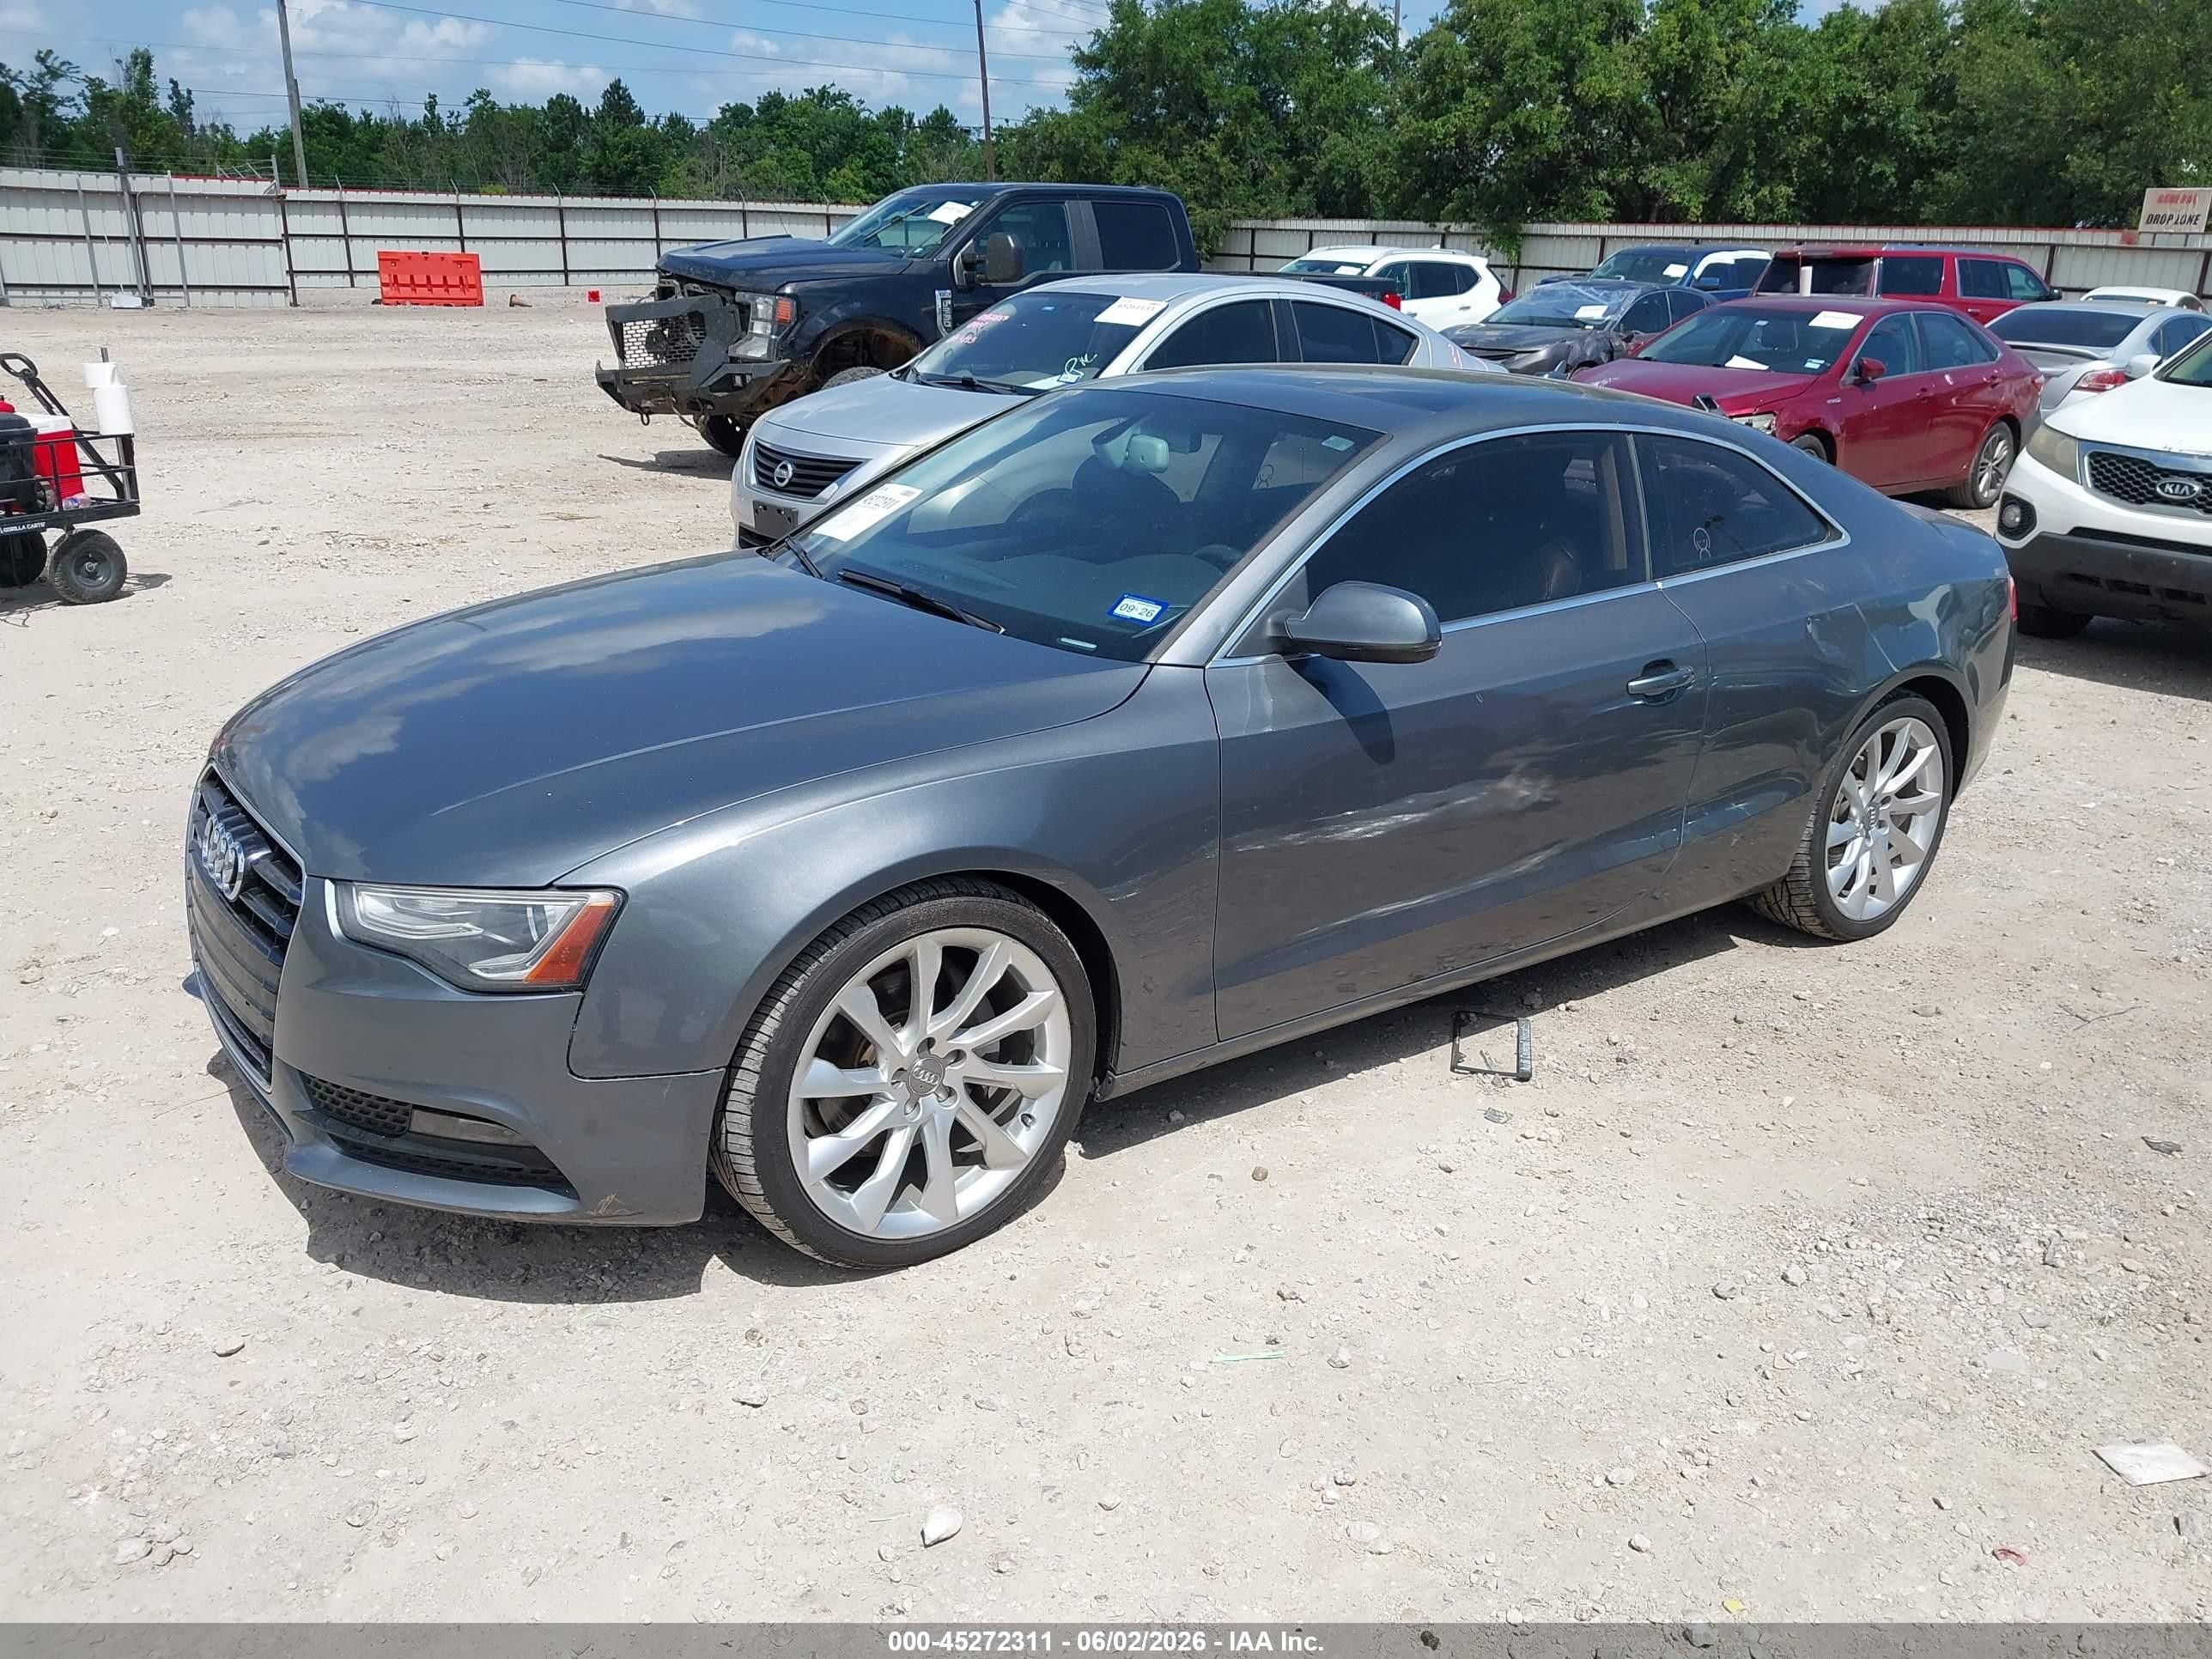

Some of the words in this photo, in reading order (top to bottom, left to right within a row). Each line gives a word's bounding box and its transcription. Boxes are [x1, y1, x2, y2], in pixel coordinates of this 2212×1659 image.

[2146, 213, 2173, 225] DROP
[2174, 214, 2201, 226] ZONE
[2164, 483, 2191, 495] KIA
[1119, 603, 1135, 613] 09
[1138, 607, 1156, 617] 26
